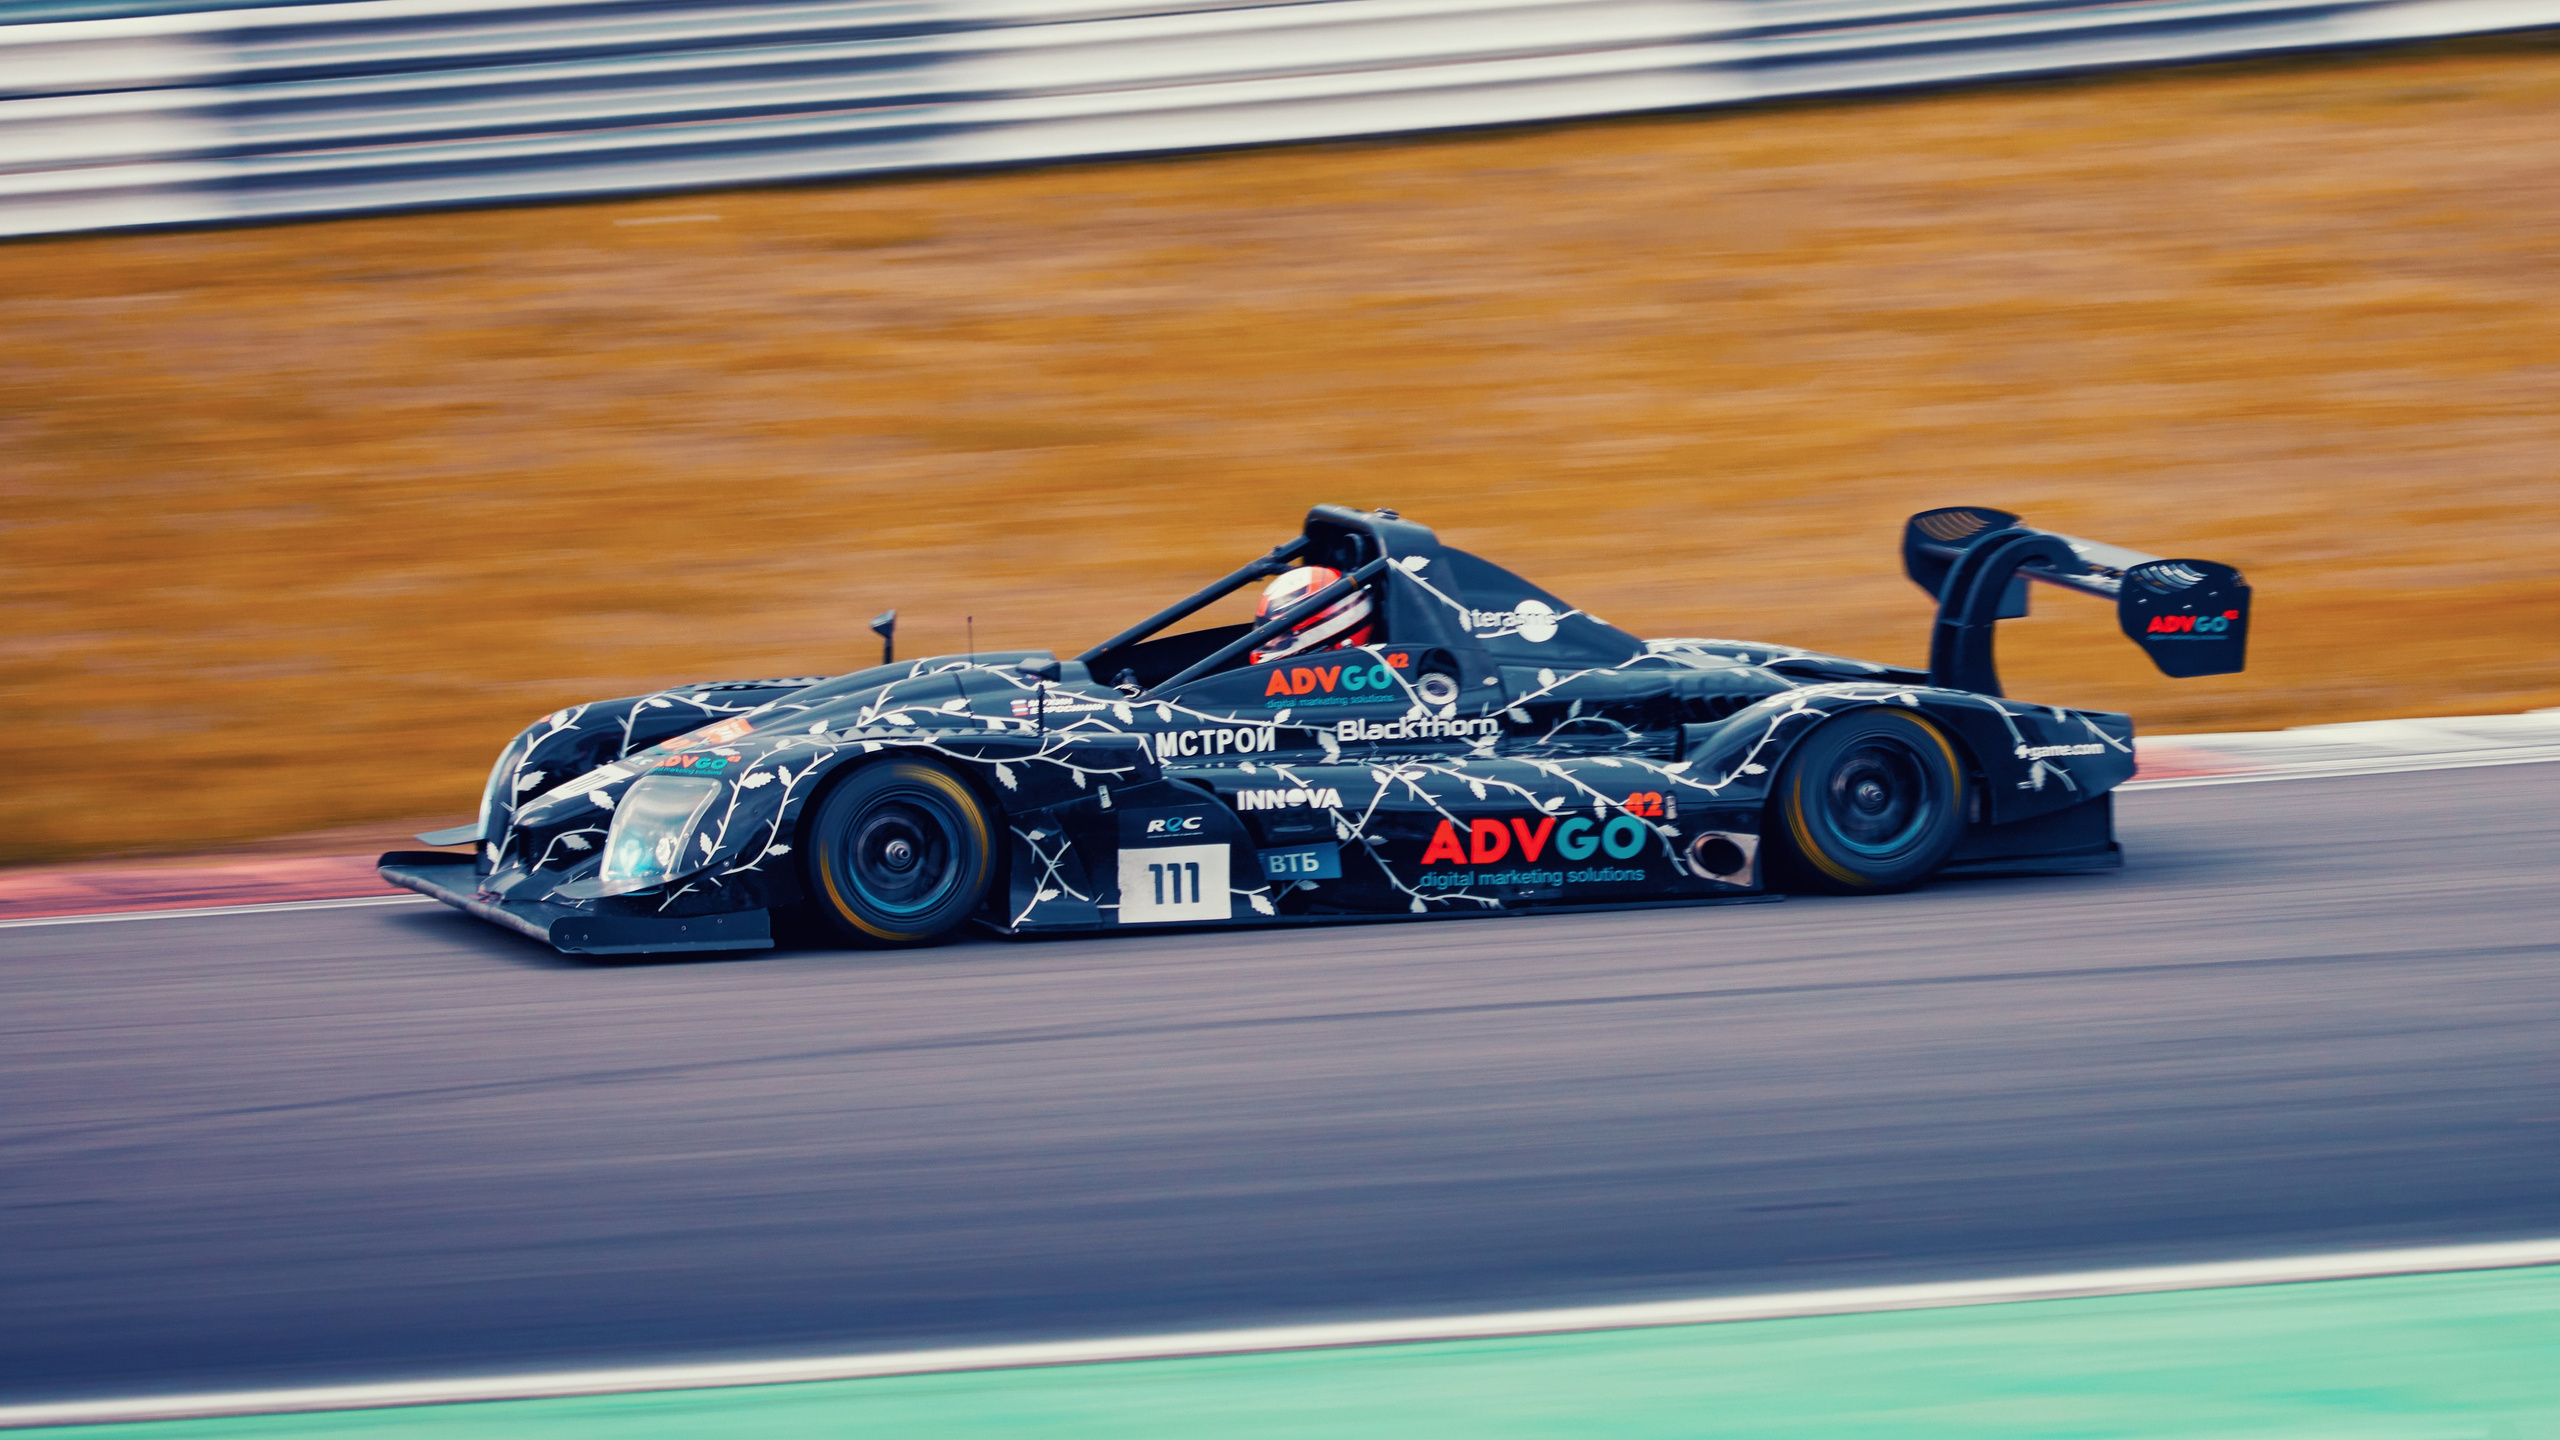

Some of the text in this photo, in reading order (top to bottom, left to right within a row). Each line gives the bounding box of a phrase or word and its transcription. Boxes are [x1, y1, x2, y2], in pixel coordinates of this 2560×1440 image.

[2146, 615, 2229, 633] ADVGO
[1265, 664, 1393, 696] ADVGO
[1265, 693, 1395, 709] digital marketing solutions
[1337, 715, 1499, 741] Blackthorn
[1237, 788, 1343, 810] INNOVA
[1420, 816, 1647, 864] ADVGO
[1269, 852, 1319, 872] ВТБ
[1148, 862, 1200, 904] 111
[1420, 866, 1646, 890] digital marketing solutions
